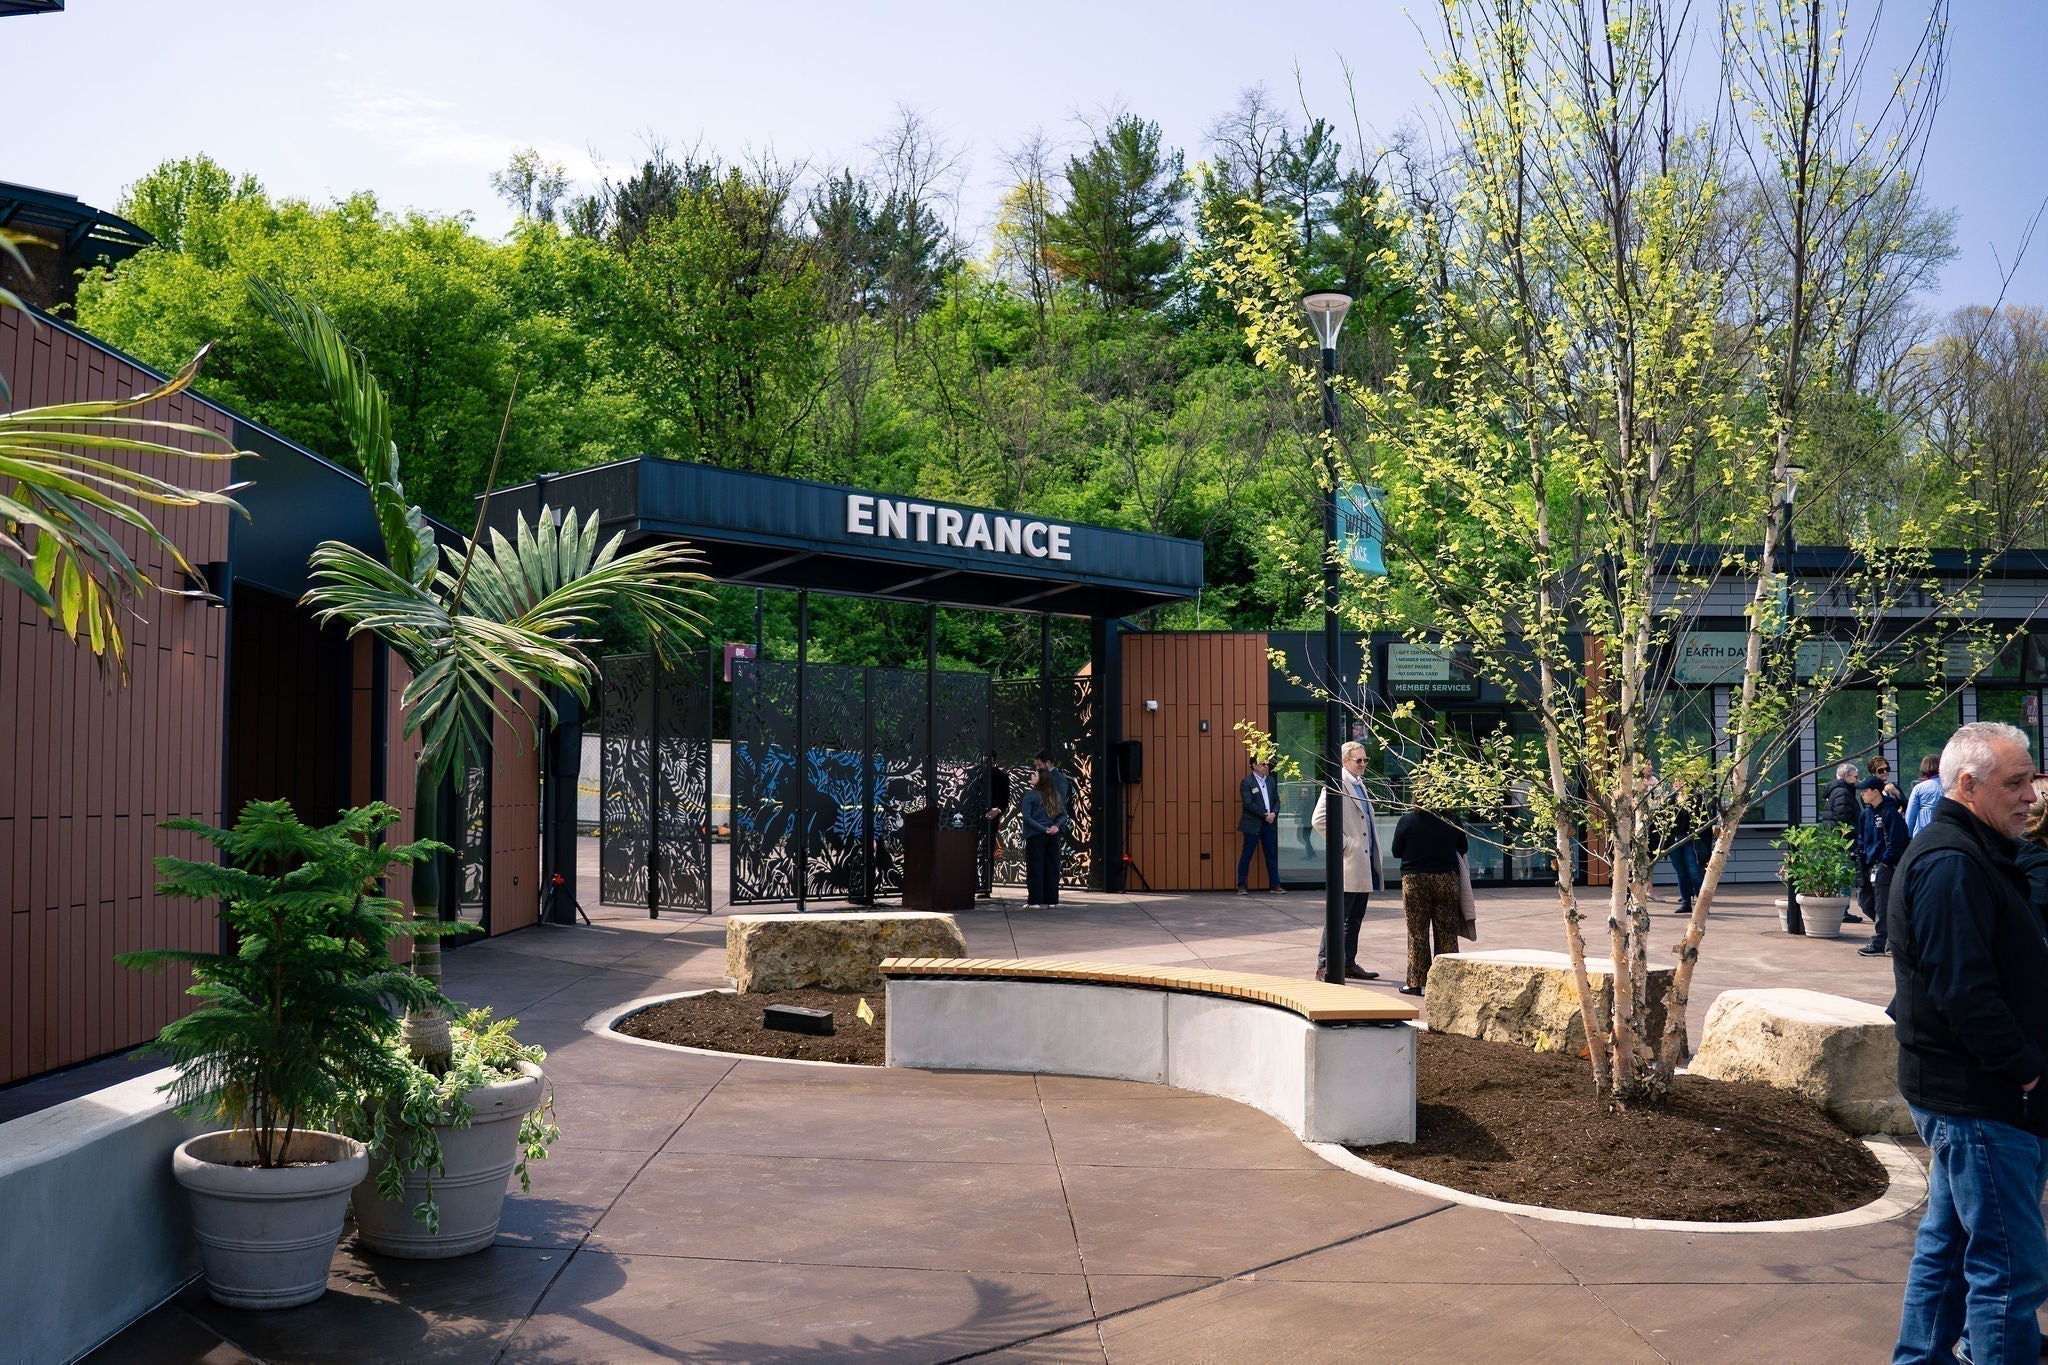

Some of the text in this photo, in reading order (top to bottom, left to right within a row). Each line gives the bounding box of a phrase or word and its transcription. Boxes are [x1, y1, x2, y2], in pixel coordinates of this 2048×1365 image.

[847, 494, 1072, 561] ENTRANCE
[1686, 647, 1724, 657] EARTH
[1395, 684, 1471, 692] MEMBER SERVICES
